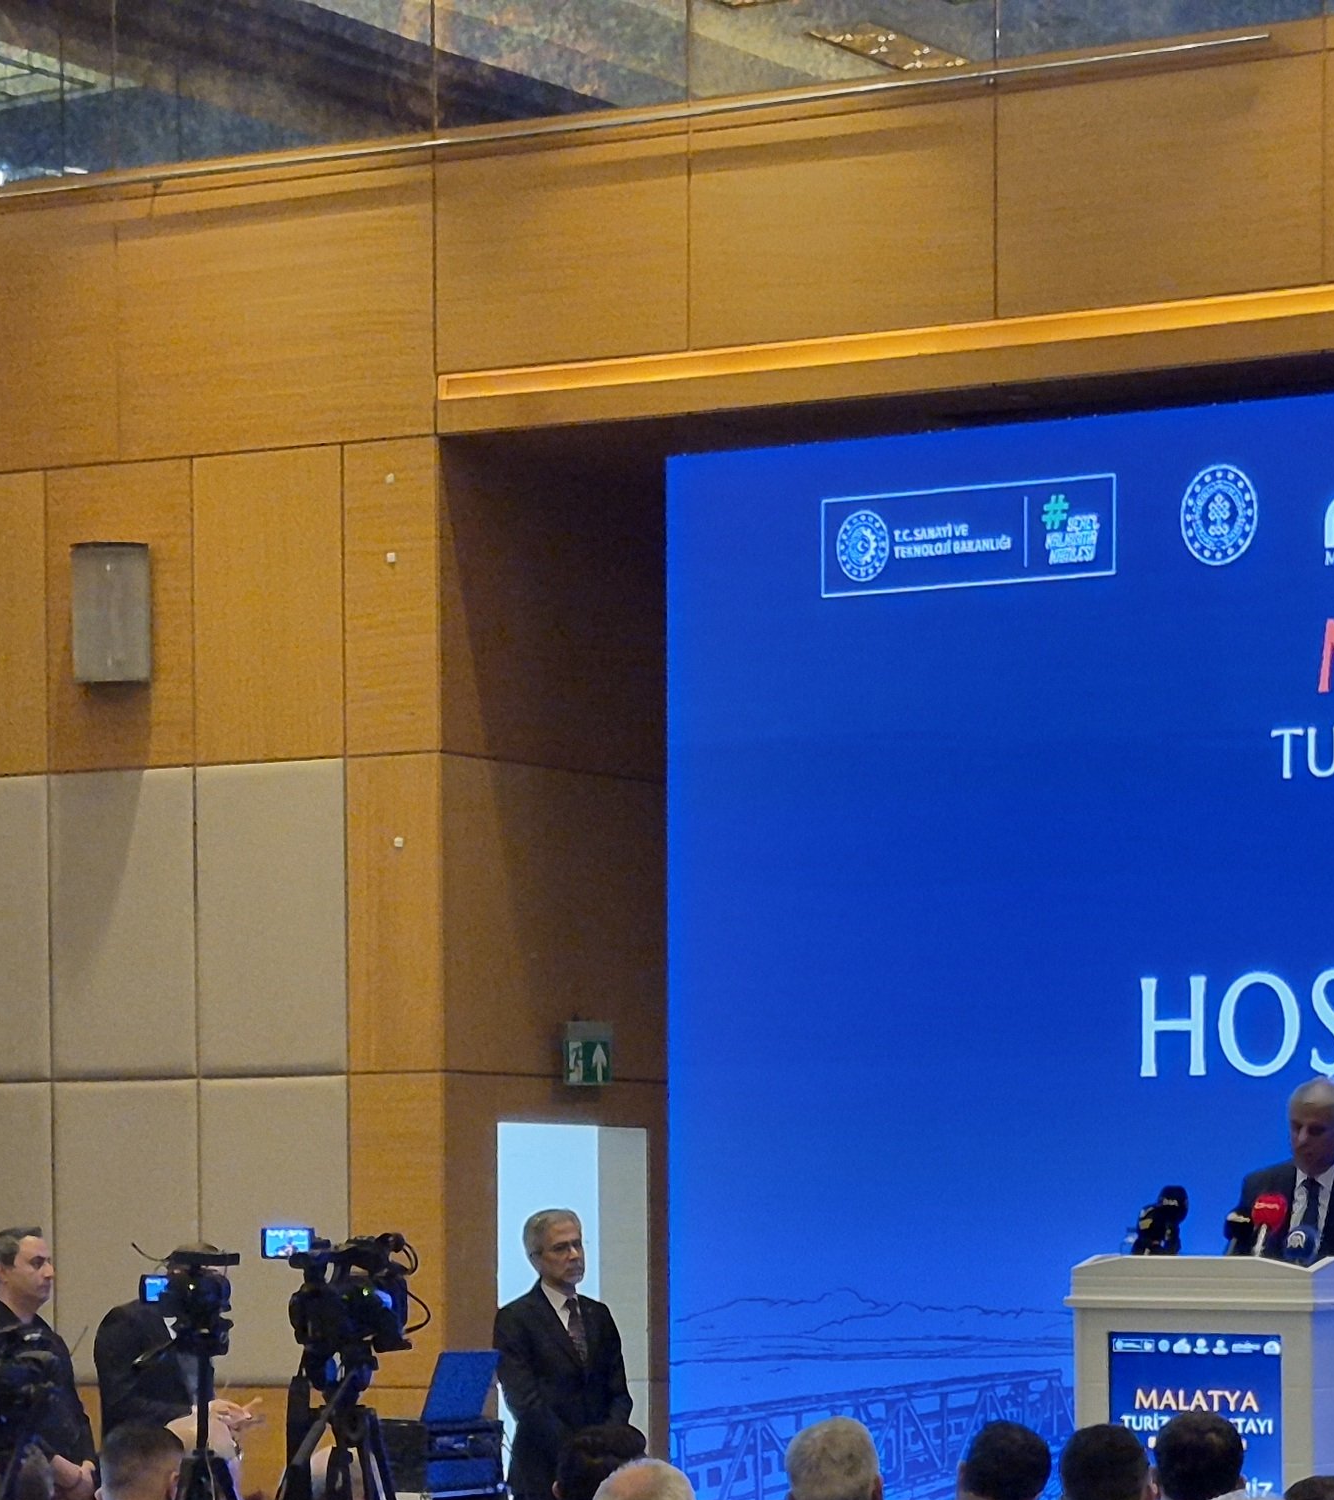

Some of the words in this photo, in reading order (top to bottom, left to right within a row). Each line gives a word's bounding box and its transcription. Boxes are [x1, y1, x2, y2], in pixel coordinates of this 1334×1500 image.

[953, 524, 969, 537] VE
[1134, 1388, 1259, 1413] MALATYA
[1120, 1413, 1171, 1432] TURİZ
